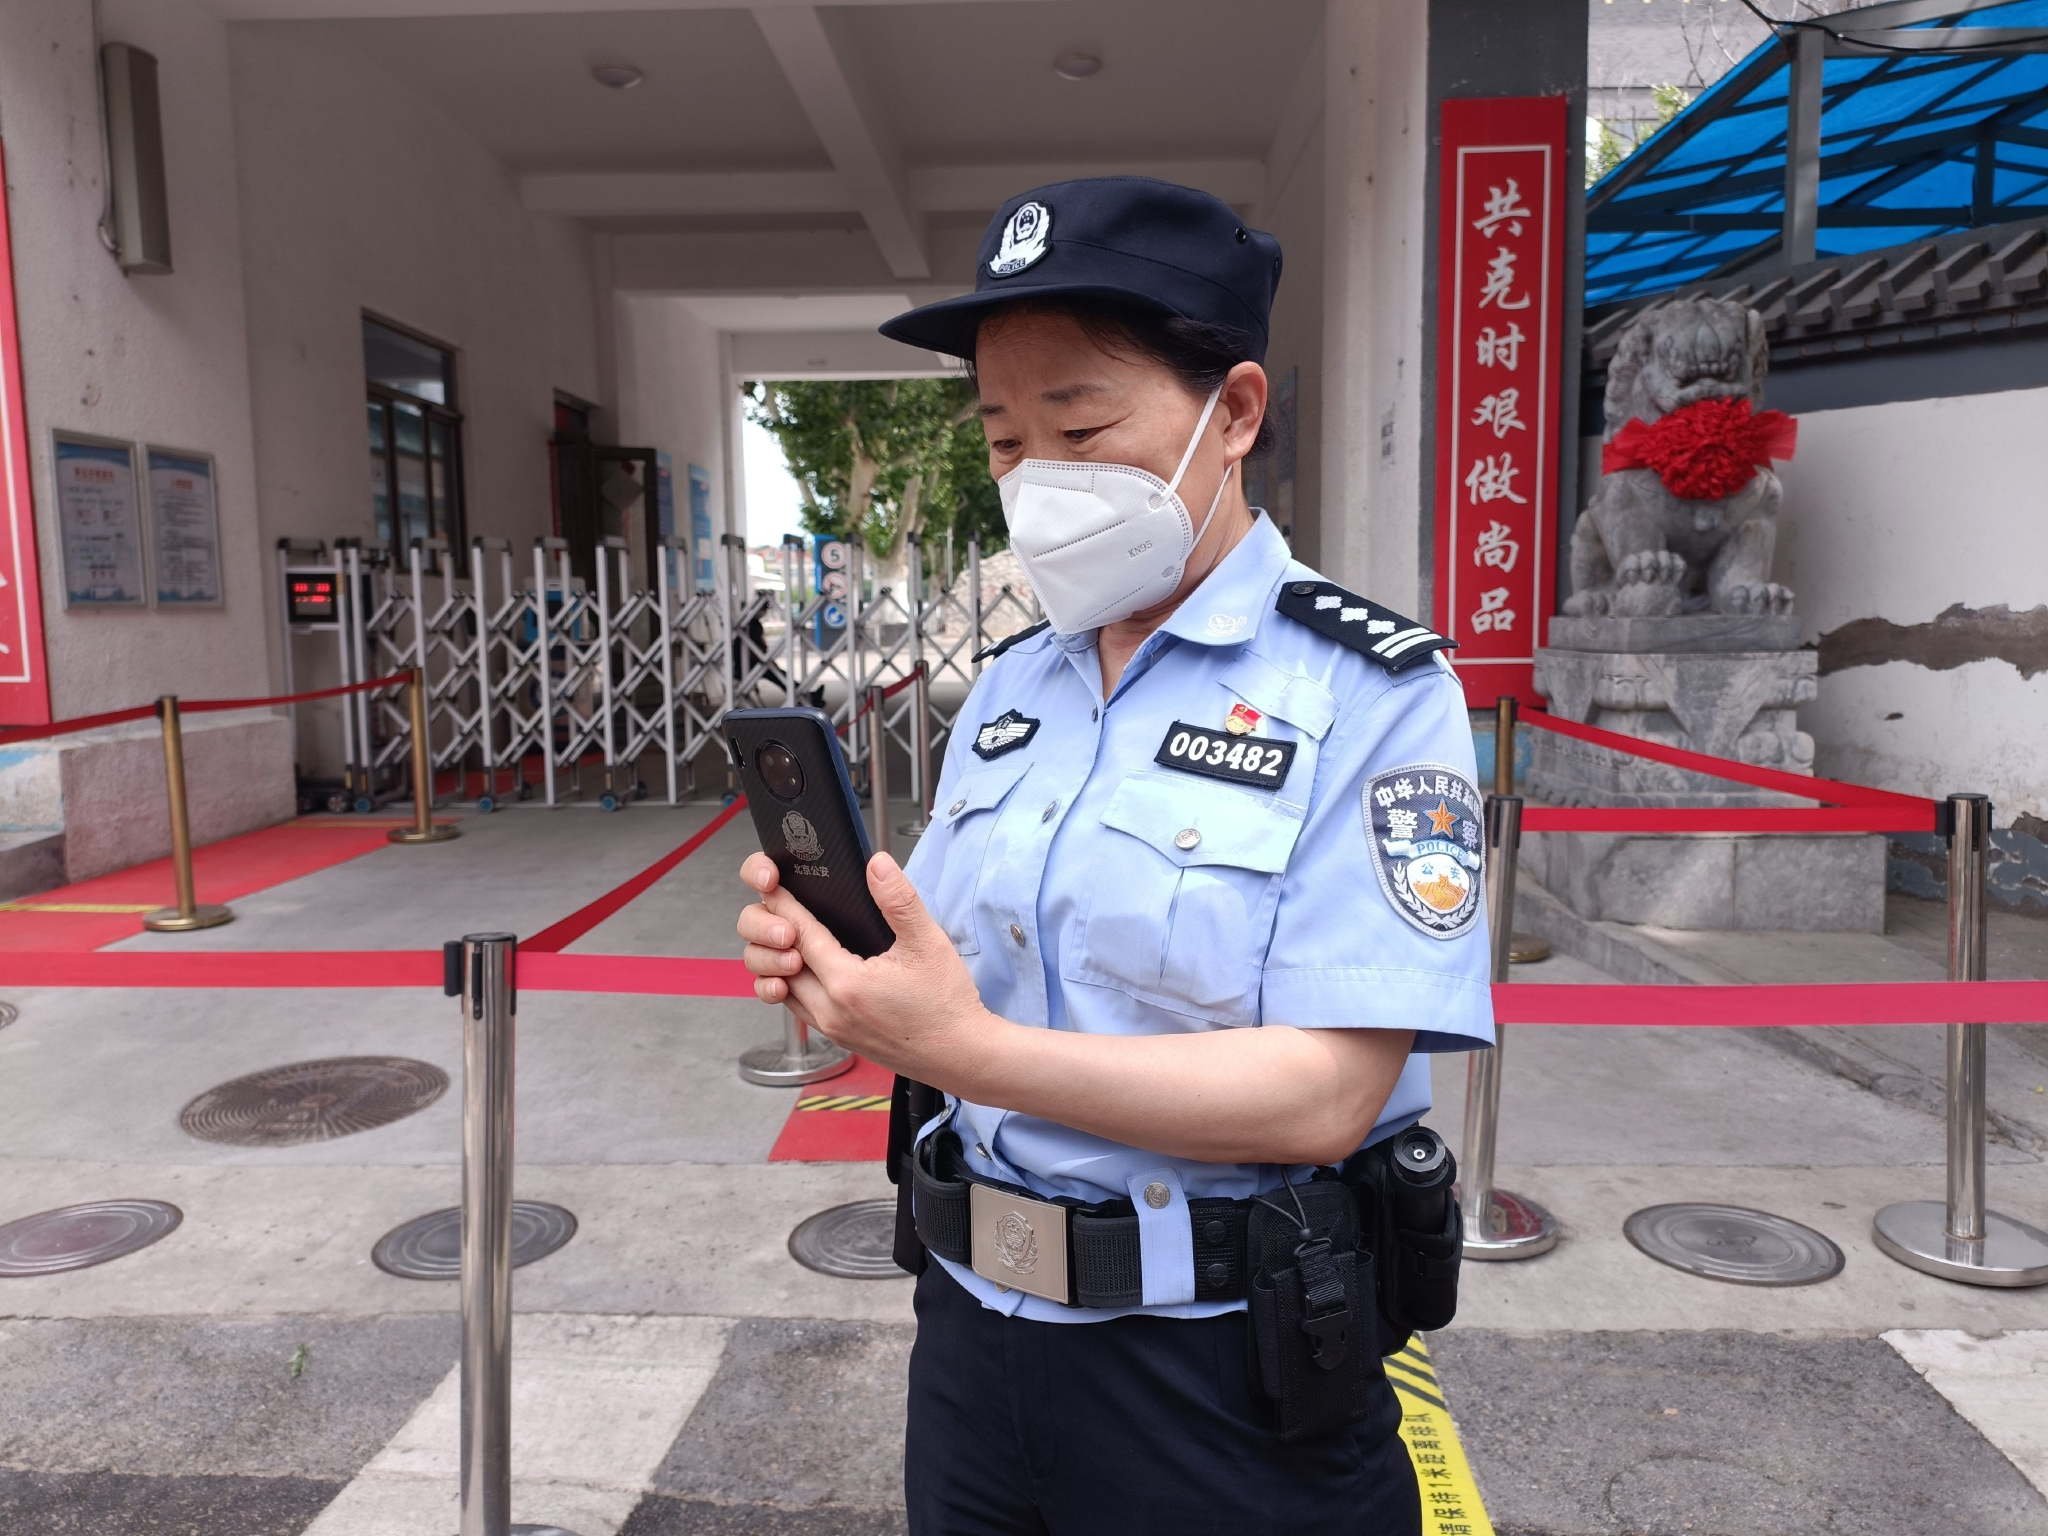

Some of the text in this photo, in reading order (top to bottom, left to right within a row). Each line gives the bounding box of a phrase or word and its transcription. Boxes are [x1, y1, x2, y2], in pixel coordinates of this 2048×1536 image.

[998, 258, 1026, 272] POLICE
[1465, 177, 1531, 634] 共克时艰做尚品
[830, 549, 840, 562] 5
[1128, 540, 1153, 558] KN95
[1170, 732, 1283, 777] 003482
[1416, 841, 1466, 861] POLICE
[793, 864, 830, 878] 北京公安
